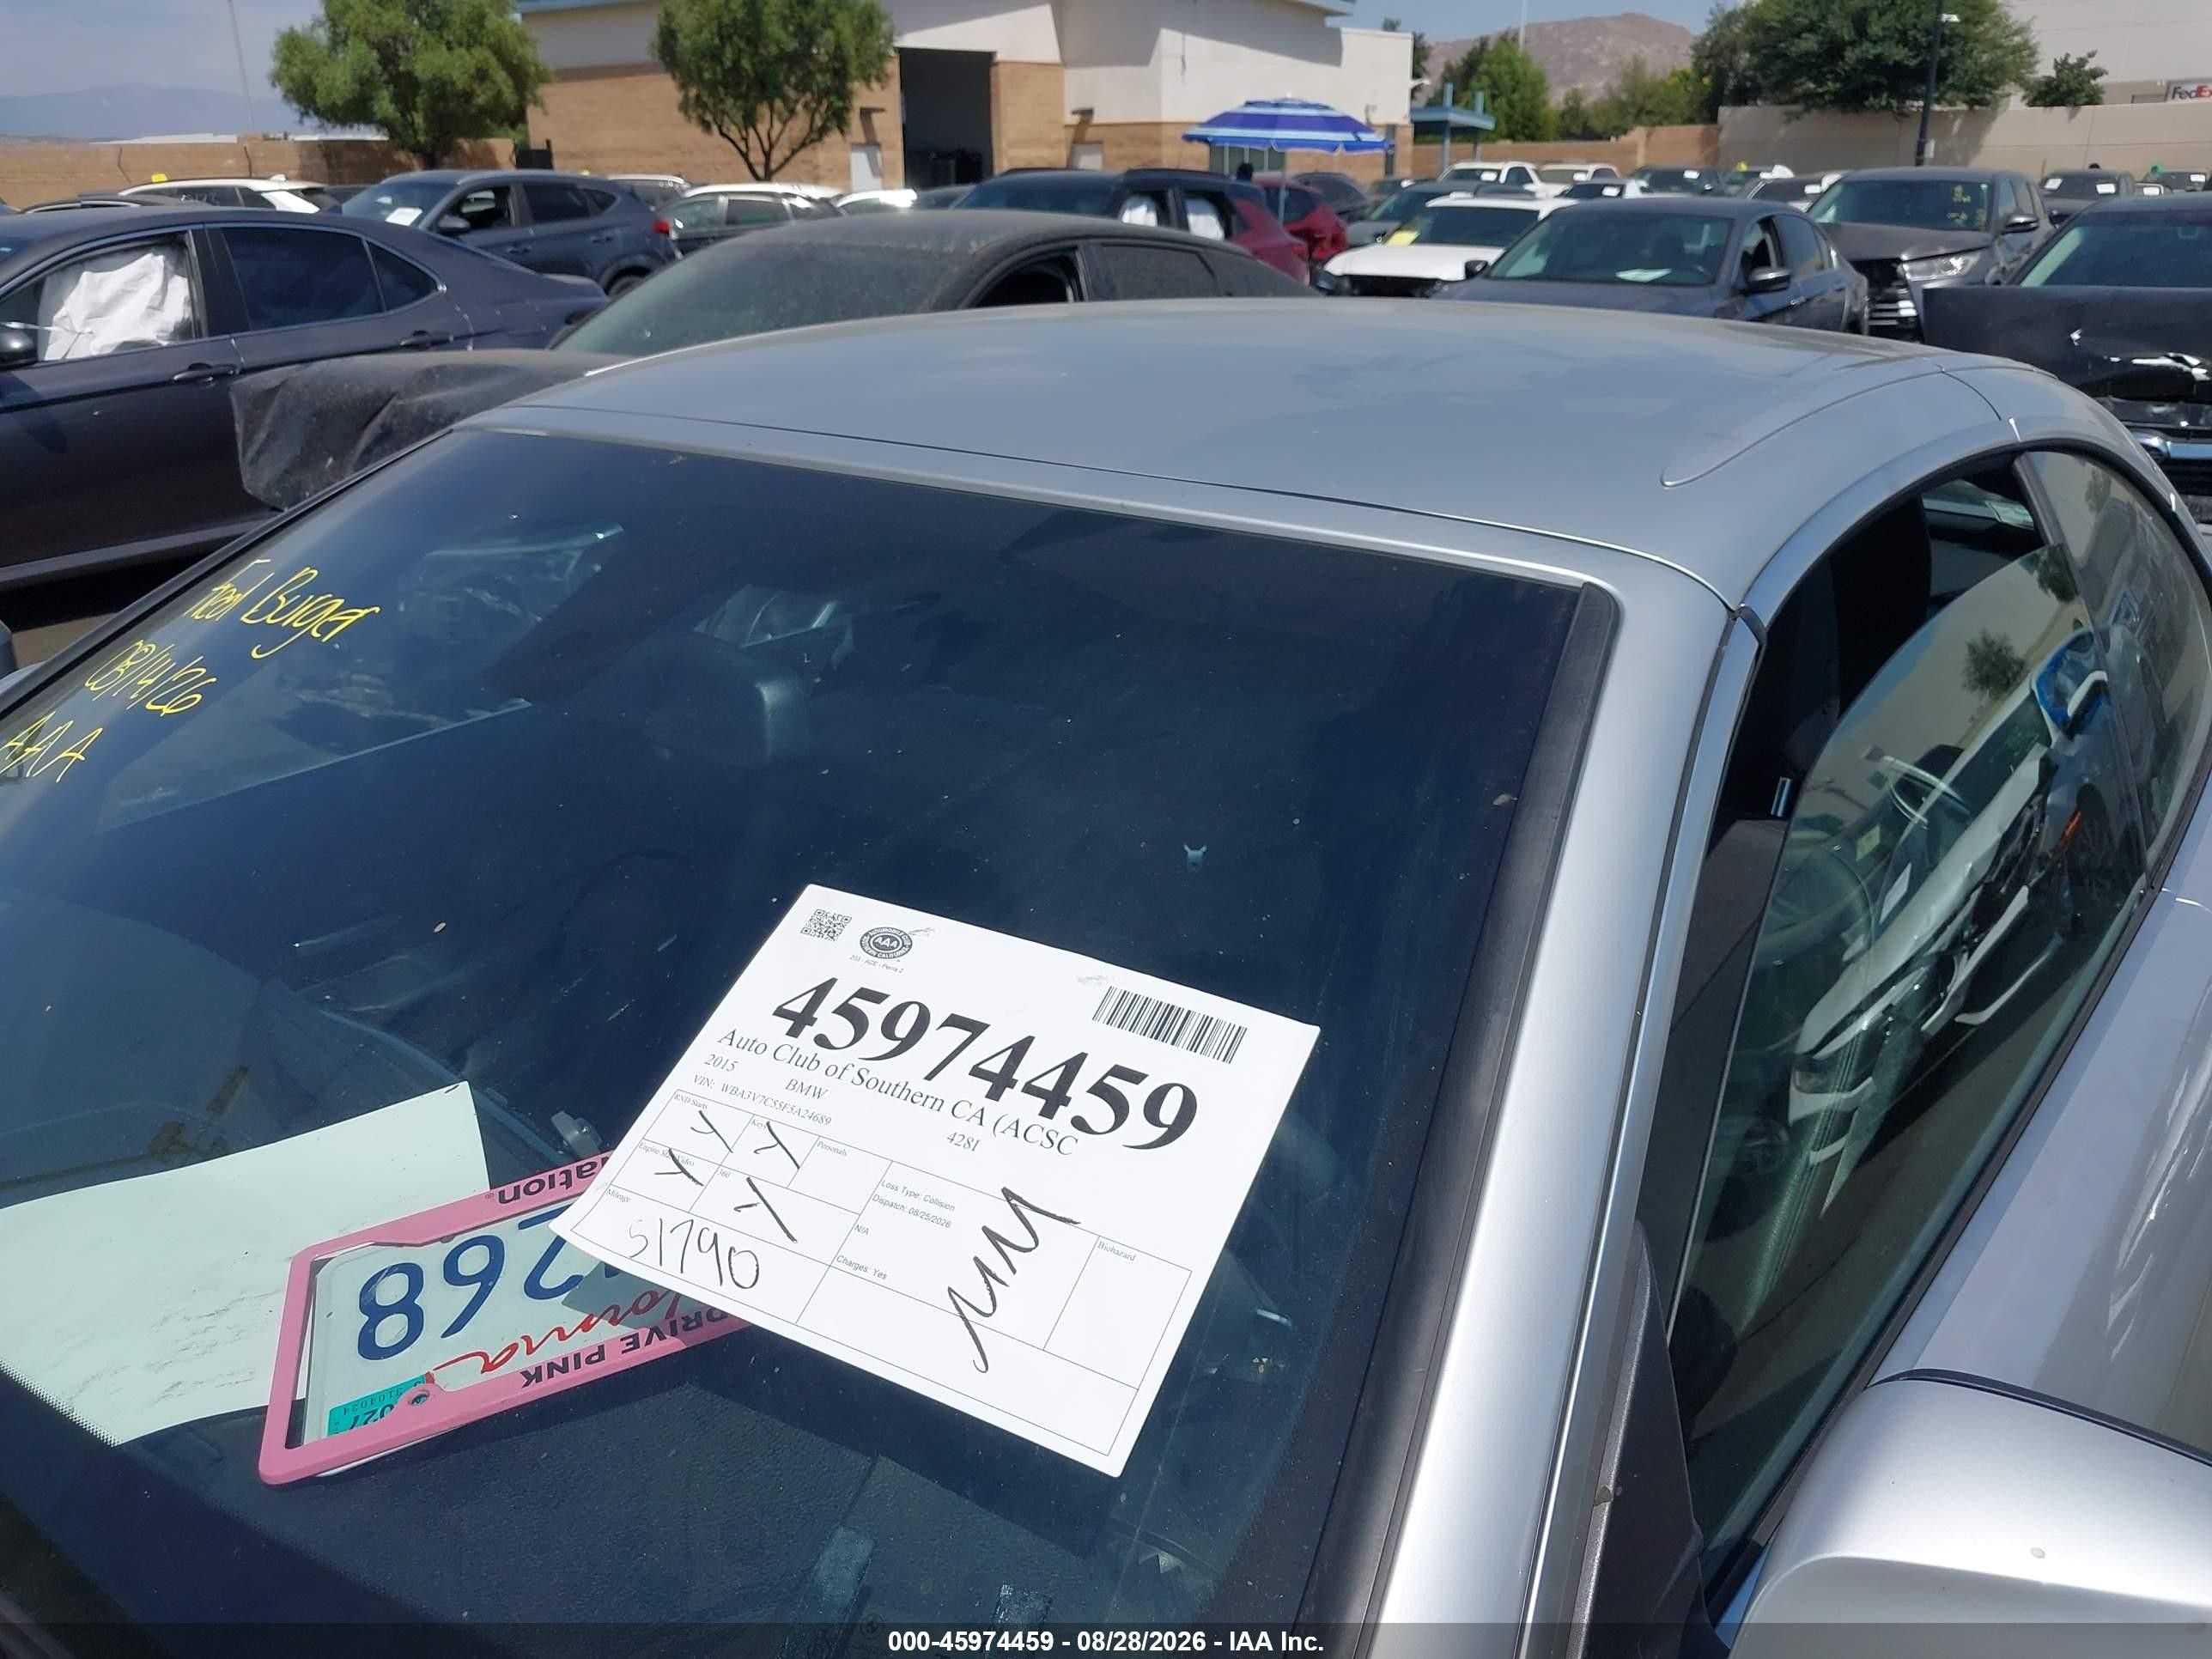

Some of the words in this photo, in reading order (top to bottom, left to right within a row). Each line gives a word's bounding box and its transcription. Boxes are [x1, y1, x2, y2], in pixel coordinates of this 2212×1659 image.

[240, 566, 381, 659] Burger
[874, 936, 898, 949] AAA
[704, 1054, 738, 1073] 2015
[785, 1079, 829, 1099] BMW
[772, 976, 1198, 1150] 45974459
[693, 1074, 715, 1089] VIN:
[717, 1029, 769, 1055] Auto
[772, 1043, 821, 1072] Club
[824, 1062, 855, 1080] of
[850, 1066, 945, 1114] Southern
[951, 1099, 985, 1127] CA
[992, 1114, 1079, 1156] (ACSC
[817, 1140, 848, 1158] Personals
[497, 1156, 610, 1205] ation
[717, 1168, 732, 1178] 360
[606, 1187, 631, 1203] Mileage
[872, 1194, 907, 1212] Dispatch:
[908, 1207, 952, 1229] 08/25/2026
[881, 1180, 899, 1192] Loss
[900, 1186, 921, 1200] Type:
[923, 1194, 956, 1212] Collision
[854, 1224, 870, 1236] N/A
[629, 1217, 760, 1290] 51790
[836, 1255, 872, 1273] Charges:
[872, 1268, 888, 1280] Yes
[1097, 1241, 1137, 1262] Biohazard
[356, 1203, 620, 1361] 268
[621, 1307, 729, 1355] DRIVE
[521, 1344, 606, 1389] PINK
